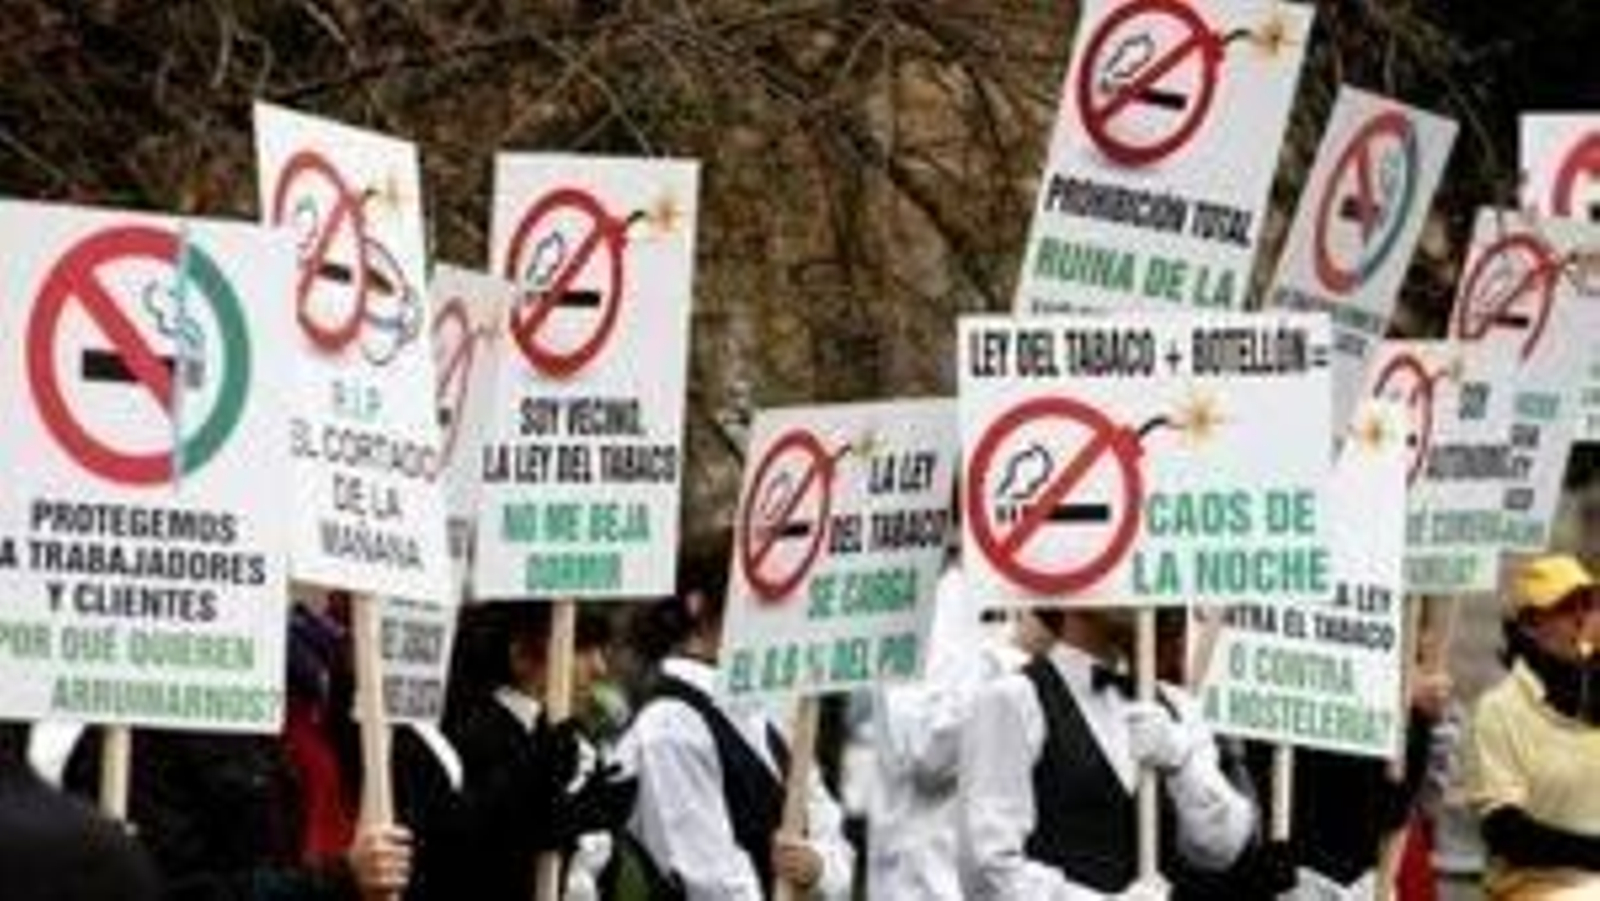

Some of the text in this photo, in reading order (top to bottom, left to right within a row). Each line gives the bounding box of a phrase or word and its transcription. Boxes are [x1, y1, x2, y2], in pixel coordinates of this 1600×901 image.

[1034, 237, 1135, 292] RUINA
[1144, 256, 1189, 303] DE
[1193, 265, 1237, 309] LA
[968, 328, 1009, 377] LEY
[1016, 328, 1059, 377] DEL
[1064, 327, 1155, 377] TABACO
[1165, 340, 1182, 371] +
[519, 397, 559, 437] SOY
[482, 444, 677, 484] LA LEY DEL TABACO
[868, 451, 936, 494] LA LEY
[333, 472, 402, 521] DE LA
[1146, 491, 1317, 535] CAOS DE
[30, 500, 238, 546] PROTEGEMOS
[503, 503, 538, 543] NO
[545, 503, 582, 543] ME
[589, 503, 651, 543] DEJA
[828, 508, 948, 554] DEL TABACO
[0, 538, 267, 585] A TRABAJADORES
[1132, 549, 1330, 596] LA NOCHE
[47, 583, 218, 622] Y CLIENTES
[807, 575, 837, 620] SE
[1355, 584, 1392, 613] LEY
[60, 623, 117, 663] QUÉ
[129, 629, 255, 671] QUIEREN
[1282, 607, 1308, 638] EL
[1313, 612, 1396, 652] TABACO
[1256, 647, 1353, 696] CONTRA
